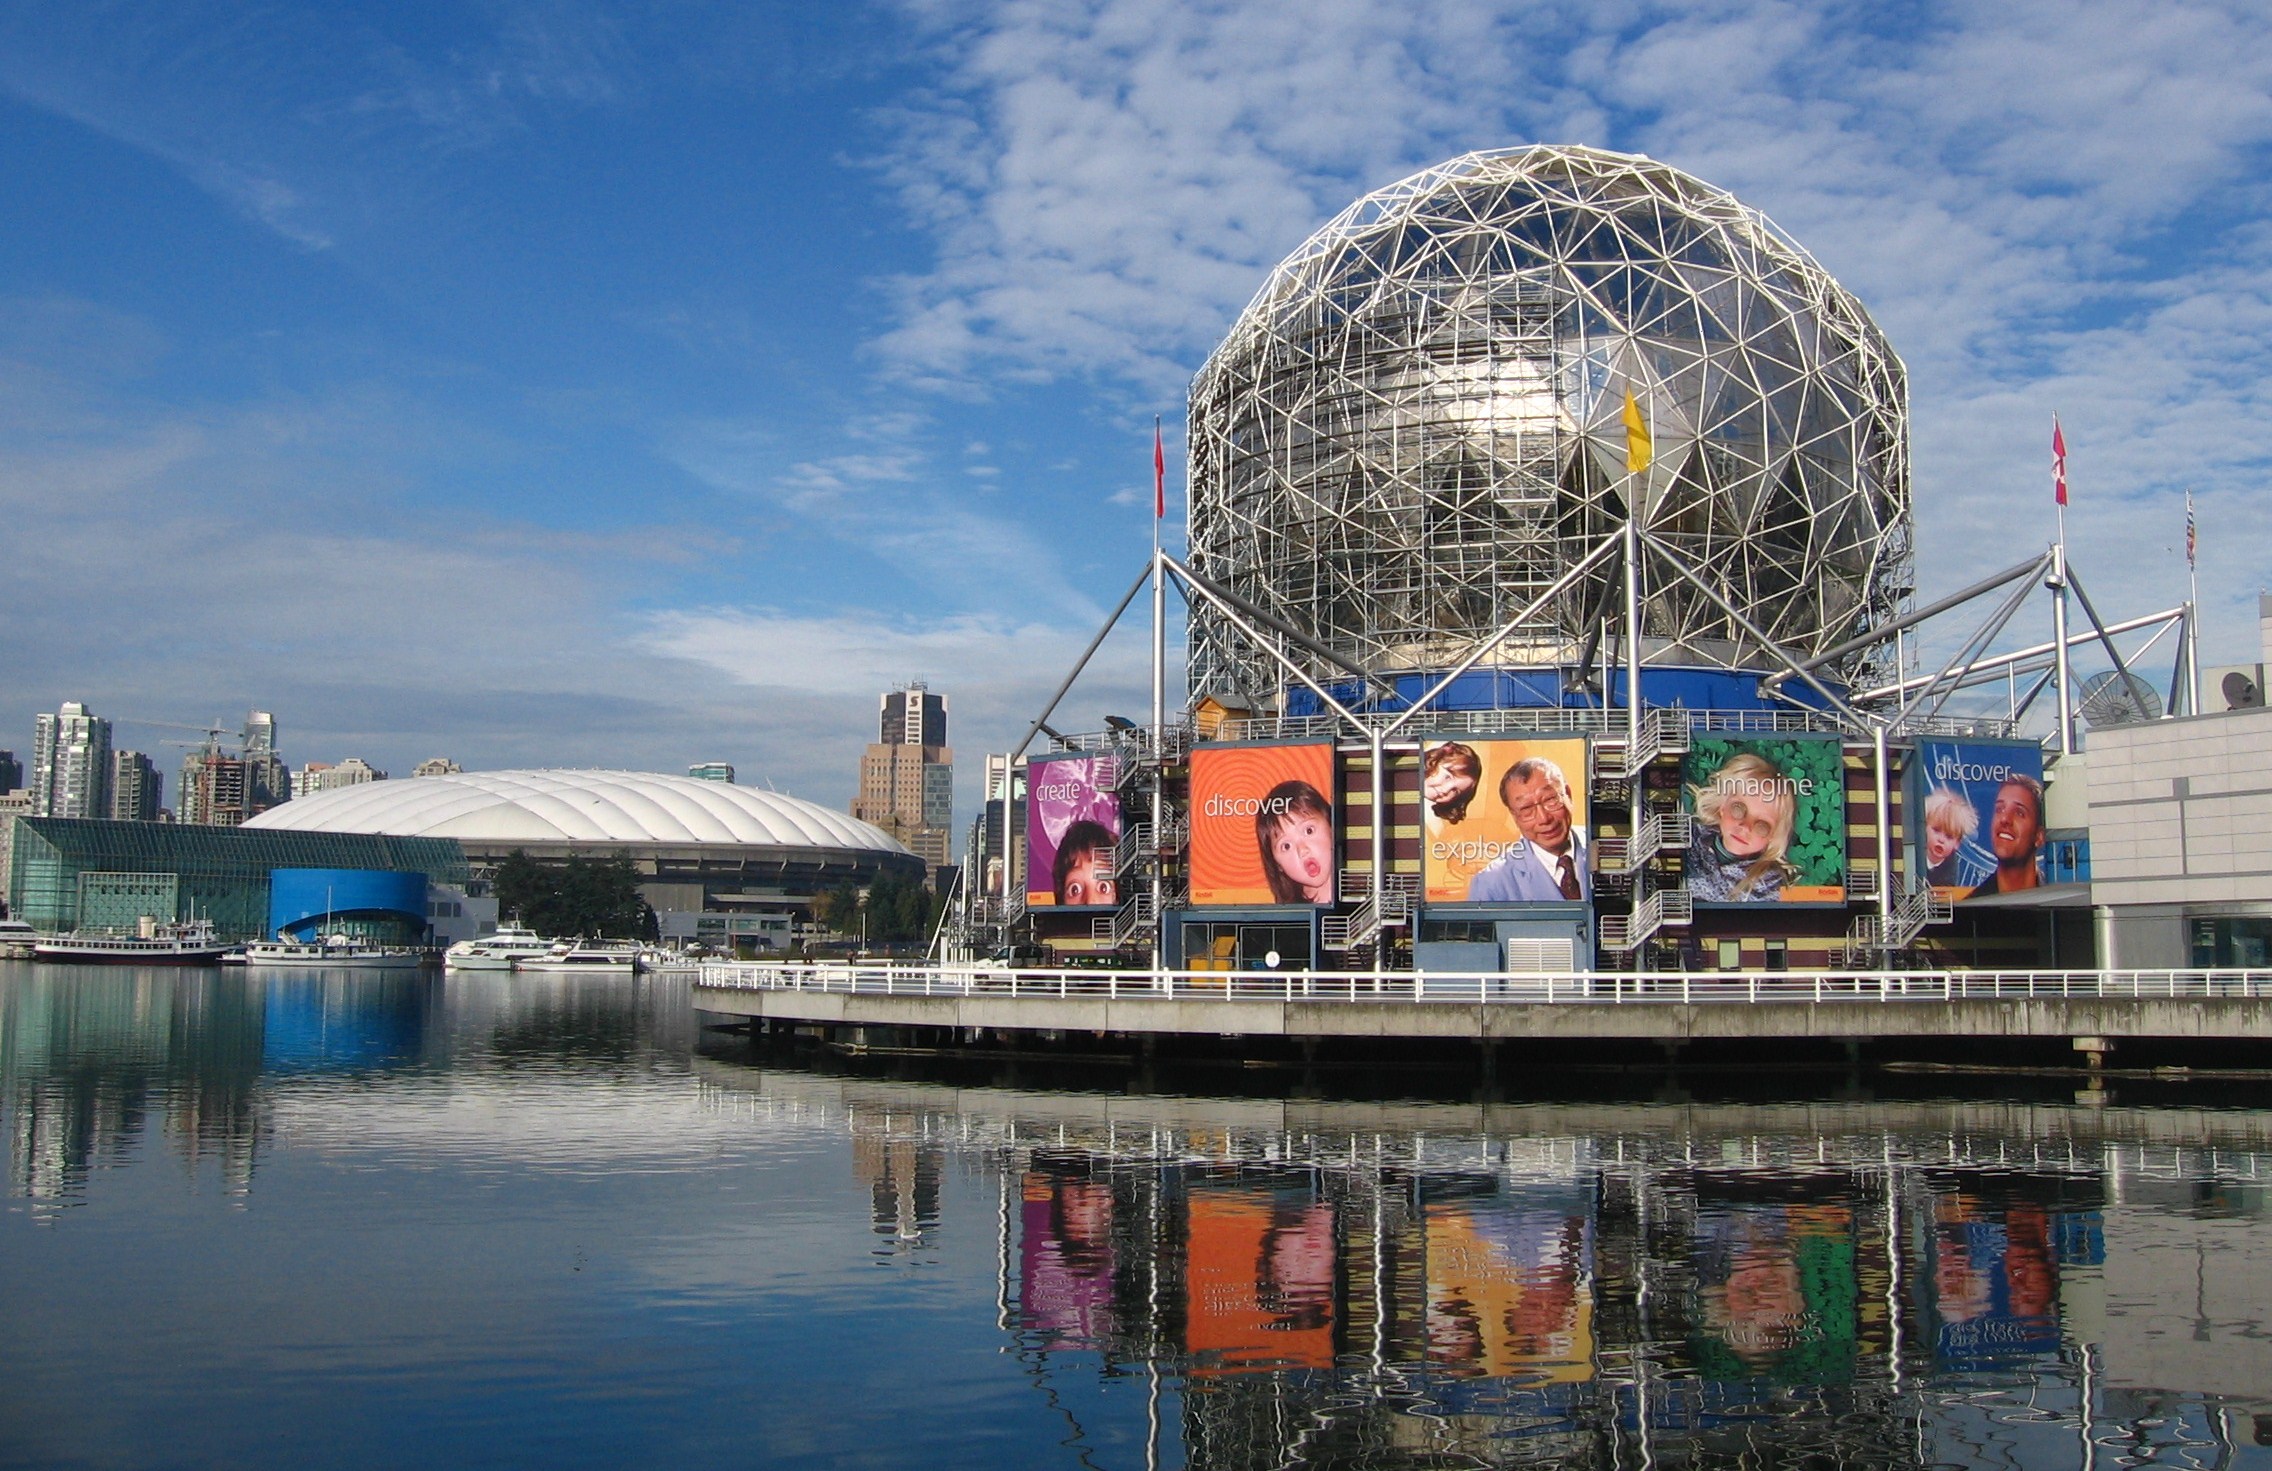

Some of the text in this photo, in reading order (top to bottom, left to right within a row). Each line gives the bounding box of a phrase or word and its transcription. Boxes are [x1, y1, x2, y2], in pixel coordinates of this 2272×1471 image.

[1934, 757, 2011, 782] discover
[1036, 783, 1081, 802] create
[1716, 772, 1813, 801] imagine
[1204, 793, 1294, 817] discover
[1431, 835, 1525, 865] explore
